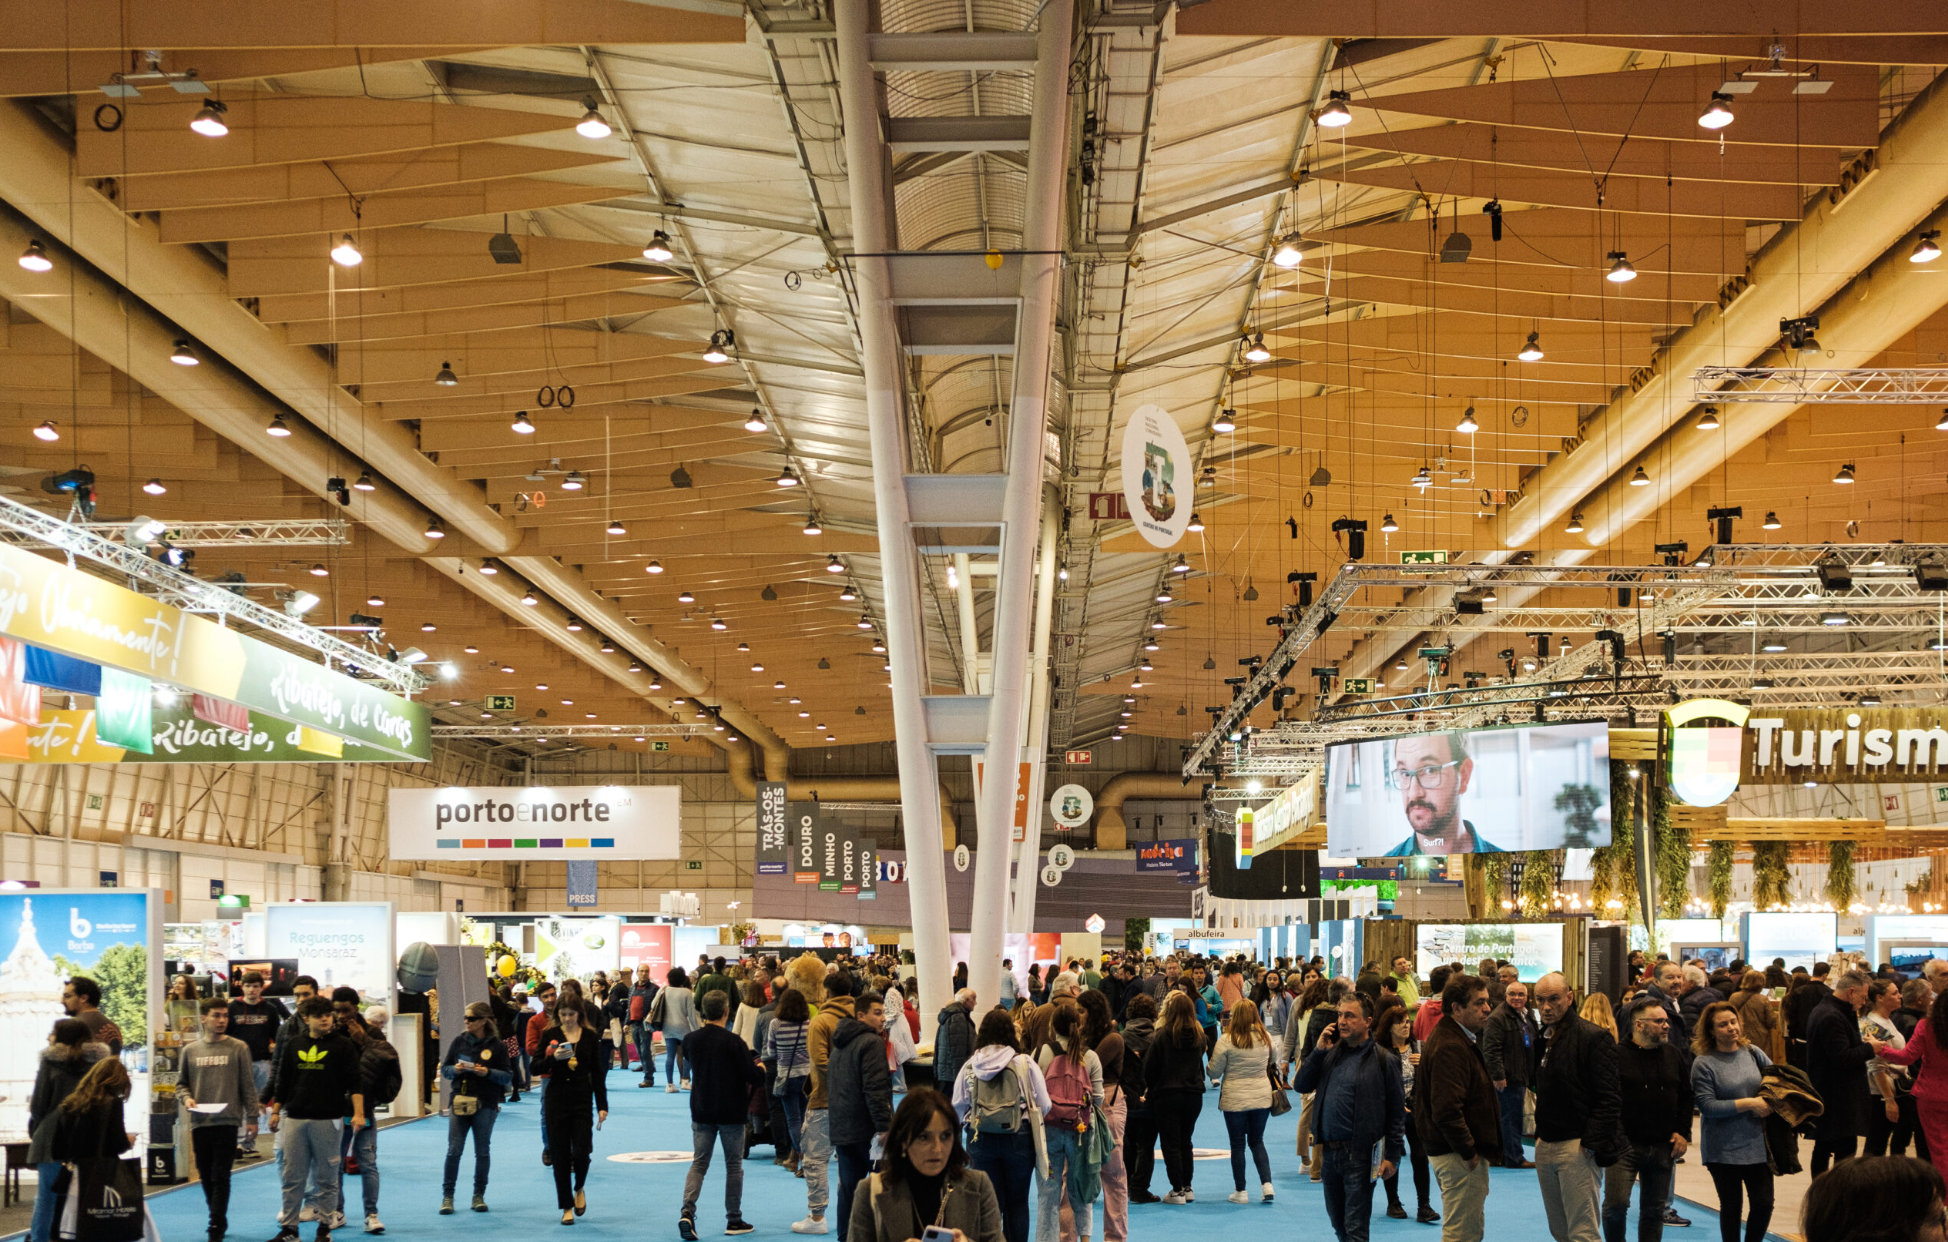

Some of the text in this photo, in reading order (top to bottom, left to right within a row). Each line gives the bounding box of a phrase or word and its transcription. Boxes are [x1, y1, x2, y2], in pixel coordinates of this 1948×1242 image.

[350, 692, 369, 728] de
[760, 786, 774, 851] TRÁS-OS-
[773, 787, 785, 851] -MONTES
[801, 815, 813, 867] DOURO
[825, 832, 836, 877] MINHO
[1423, 838, 1445, 847] Surf?!
[843, 840, 853, 881] PORTO
[861, 850, 871, 888] PORTO
[569, 894, 596, 904] PRESS
[289, 932, 365, 946] Reguengos
[1188, 930, 1225, 938] albufeira
[1442, 942, 1474, 954] Centro
[1478, 943, 1490, 954] de
[299, 948, 357, 958] Monsaraz
